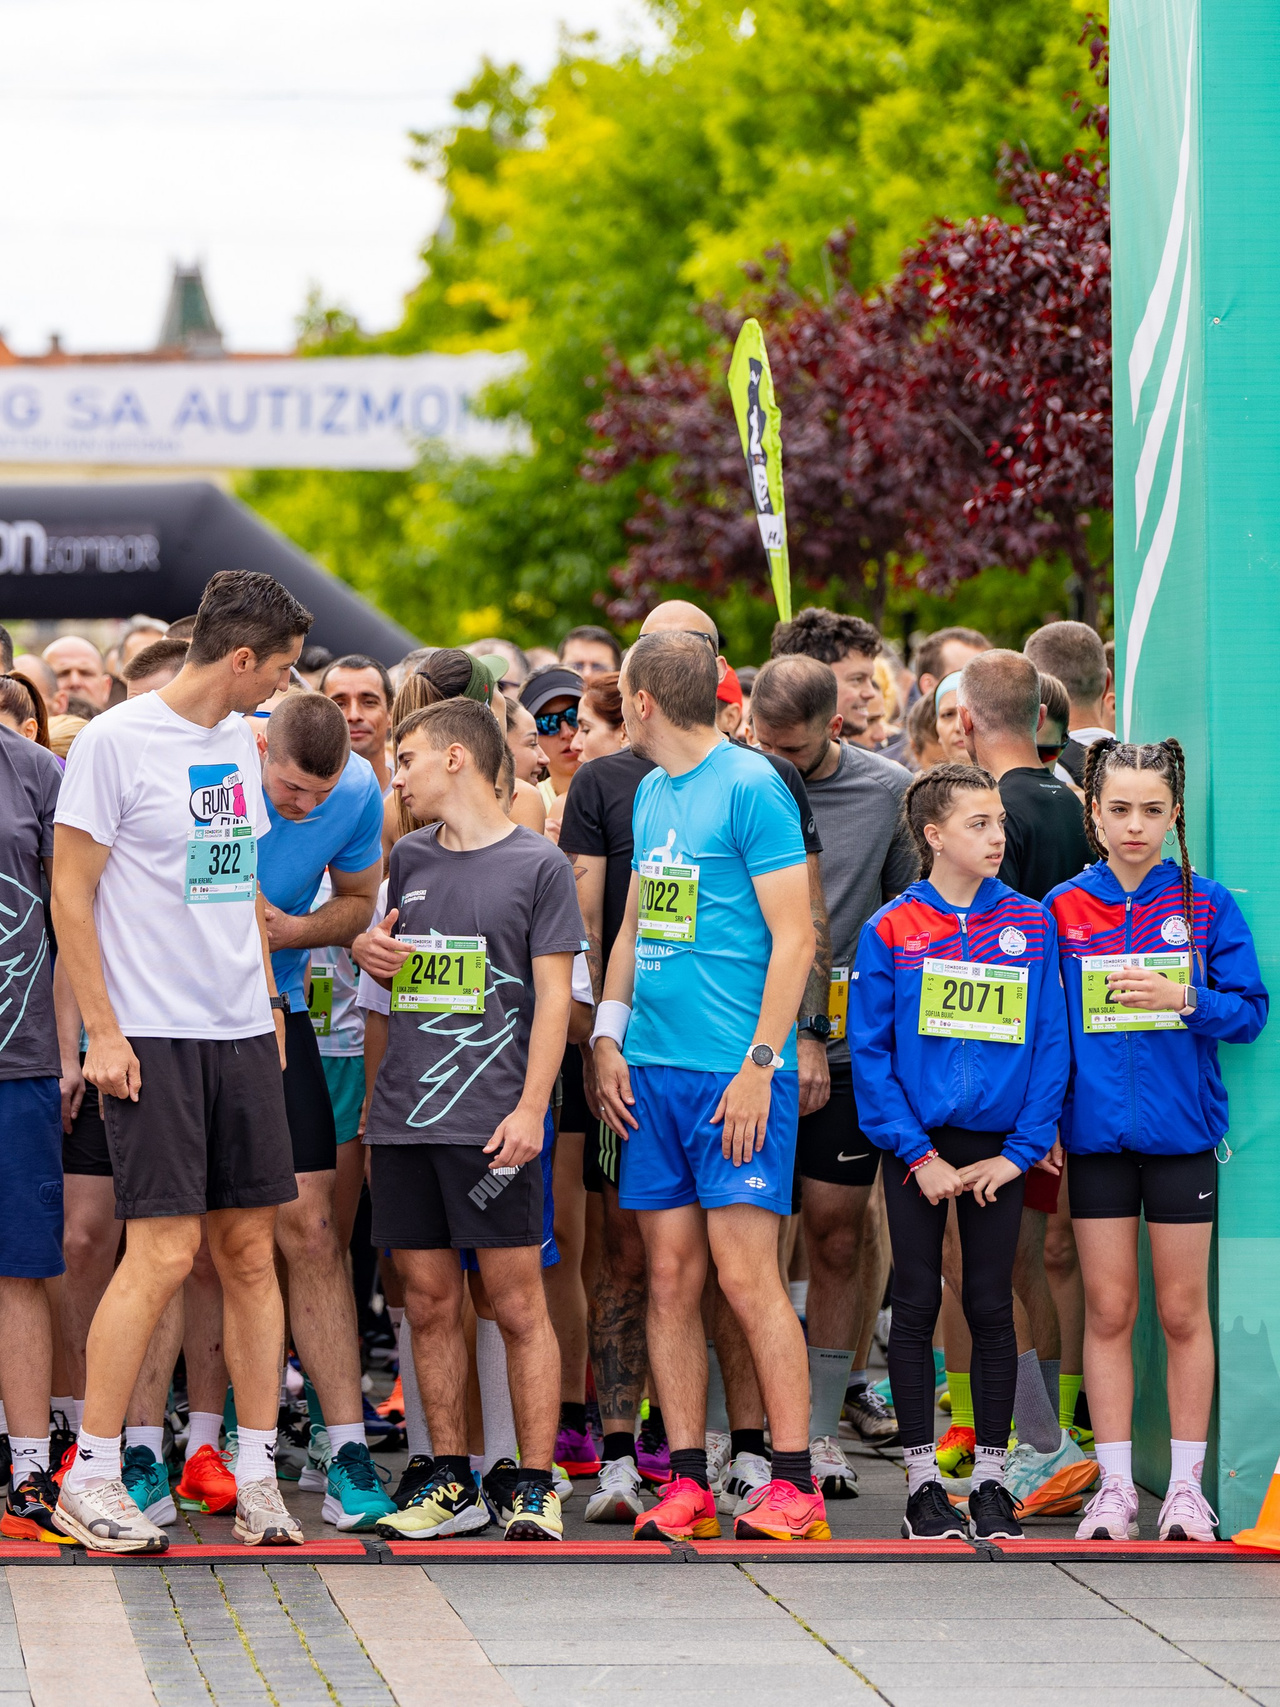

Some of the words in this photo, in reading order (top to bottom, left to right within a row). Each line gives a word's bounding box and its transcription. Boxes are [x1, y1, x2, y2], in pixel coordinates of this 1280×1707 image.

[66, 384, 148, 431] SA
[203, 788, 230, 816] RUN
[208, 843, 241, 875] 322
[674, 915, 684, 923] SRB
[411, 954, 465, 986] 2421
[636, 959, 662, 971] CLUB
[942, 979, 1005, 1015] 2071
[924, 1009, 940, 1018] SOFIJA
[1088, 1006, 1100, 1014] NINA
[1002, 1017, 1012, 1025] SRB
[910, 1445, 933, 1456] JUST
[981, 1447, 1006, 1457] JUST
